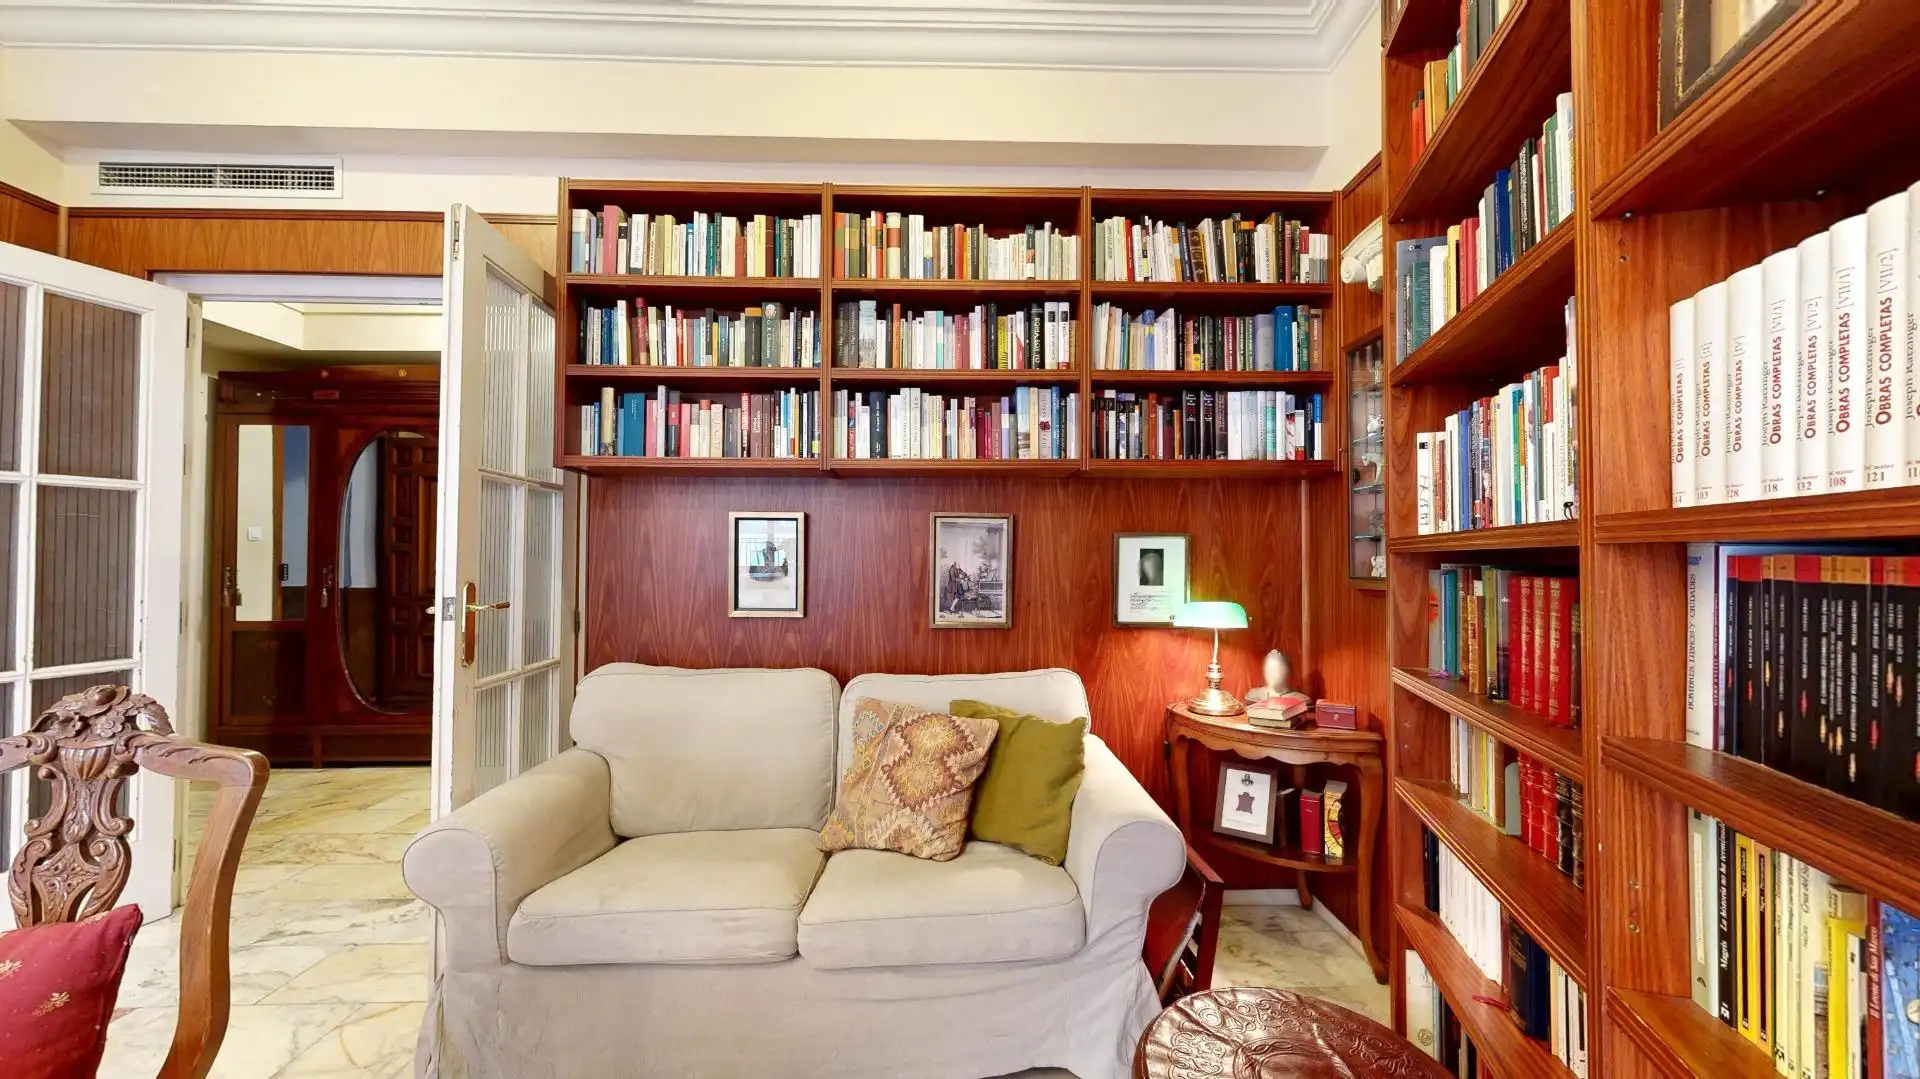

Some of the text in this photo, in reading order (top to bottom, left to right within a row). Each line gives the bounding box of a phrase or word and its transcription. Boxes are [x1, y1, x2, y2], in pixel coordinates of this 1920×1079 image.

[1839, 313, 1851, 382] COMPLETAS
[1879, 298, 1892, 371] COMPLETAS
[1772, 336, 1782, 399] COMPLETAS
[1807, 335, 1817, 396] COMPLETAS
[1866, 328, 1876, 428] Joseph Ratzinger
[1904, 312, 1916, 420] Joseph Ratzinger
[1702, 362, 1710, 417] COMPLETAS
[1734, 360, 1743, 414] COMPLETAS
[1875, 377, 1892, 425] OBRAS
[1762, 412, 1770, 447] Joseph
[1770, 404, 1782, 445] OBRAS
[1804, 400, 1817, 439] OBRAS
[1828, 398, 1836, 436] Joseph
[1836, 388, 1851, 433] OBRAS
[1675, 429, 1684, 463] OBRAS
[1701, 421, 1711, 457] OBRAS
[1733, 417, 1742, 453] OBRAS
[1764, 484, 1778, 493] 118
[1829, 477, 1847, 488] 108
[1866, 472, 1885, 483] 121
[1908, 467, 1920, 478] 11
[1688, 574, 1696, 618] CIUDADES
[1720, 863, 1727, 873] ha
[1721, 875, 1727, 886] no
[1720, 888, 1728, 918] historia
[1720, 920, 1728, 932] La
[1720, 940, 1729, 971] Magris
[1869, 927, 1880, 1019] Il Leone di San Marco
